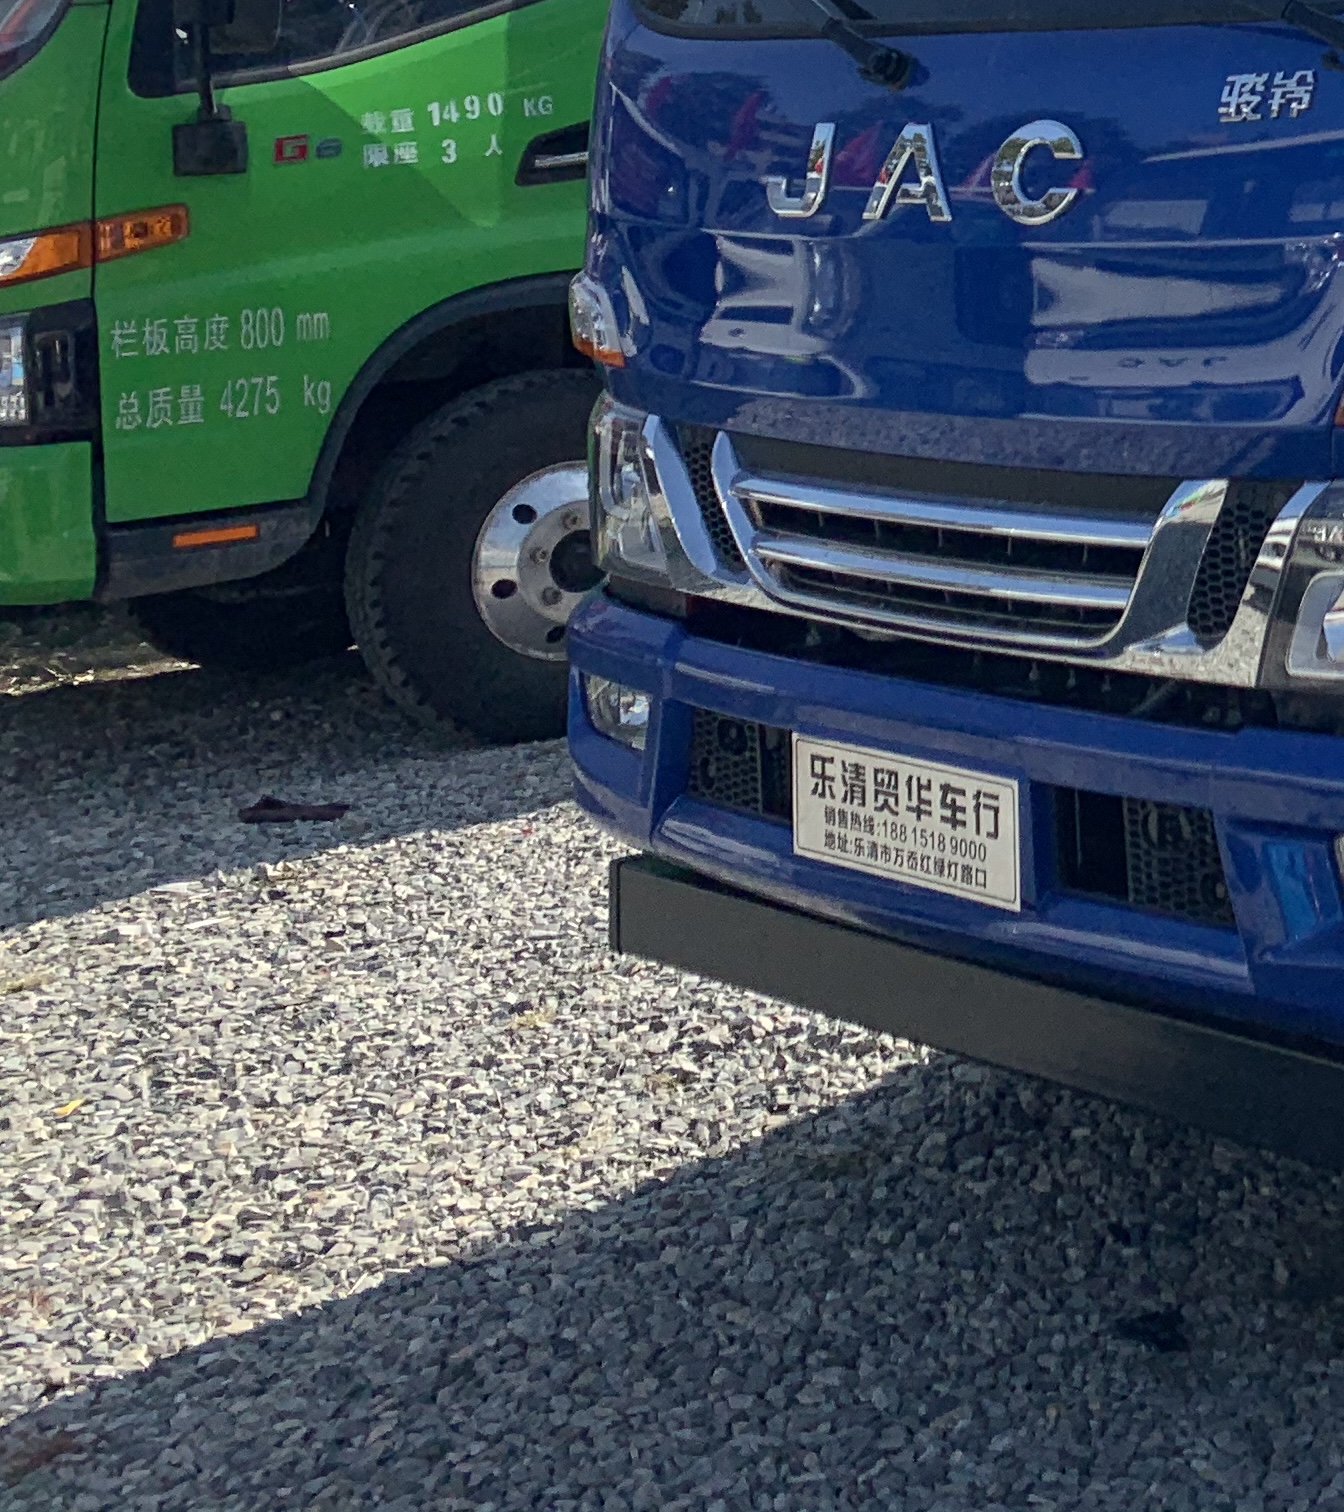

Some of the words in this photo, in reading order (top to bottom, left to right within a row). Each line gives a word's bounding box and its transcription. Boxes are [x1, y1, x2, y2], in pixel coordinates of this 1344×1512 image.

[427, 91, 504, 127] 1490
[523, 95, 553, 118] KG
[441, 139, 457, 163] 3
[484, 133, 503, 157] 人
[766, 120, 1085, 226] JAC
[110, 313, 229, 359] 栏板高度
[240, 307, 285, 349] 800
[295, 309, 330, 342] mm
[115, 385, 205, 431] 总质量
[219, 375, 281, 422] 4275
[302, 374, 332, 415] kg
[810, 752, 1000, 840] 乐清贸华车行
